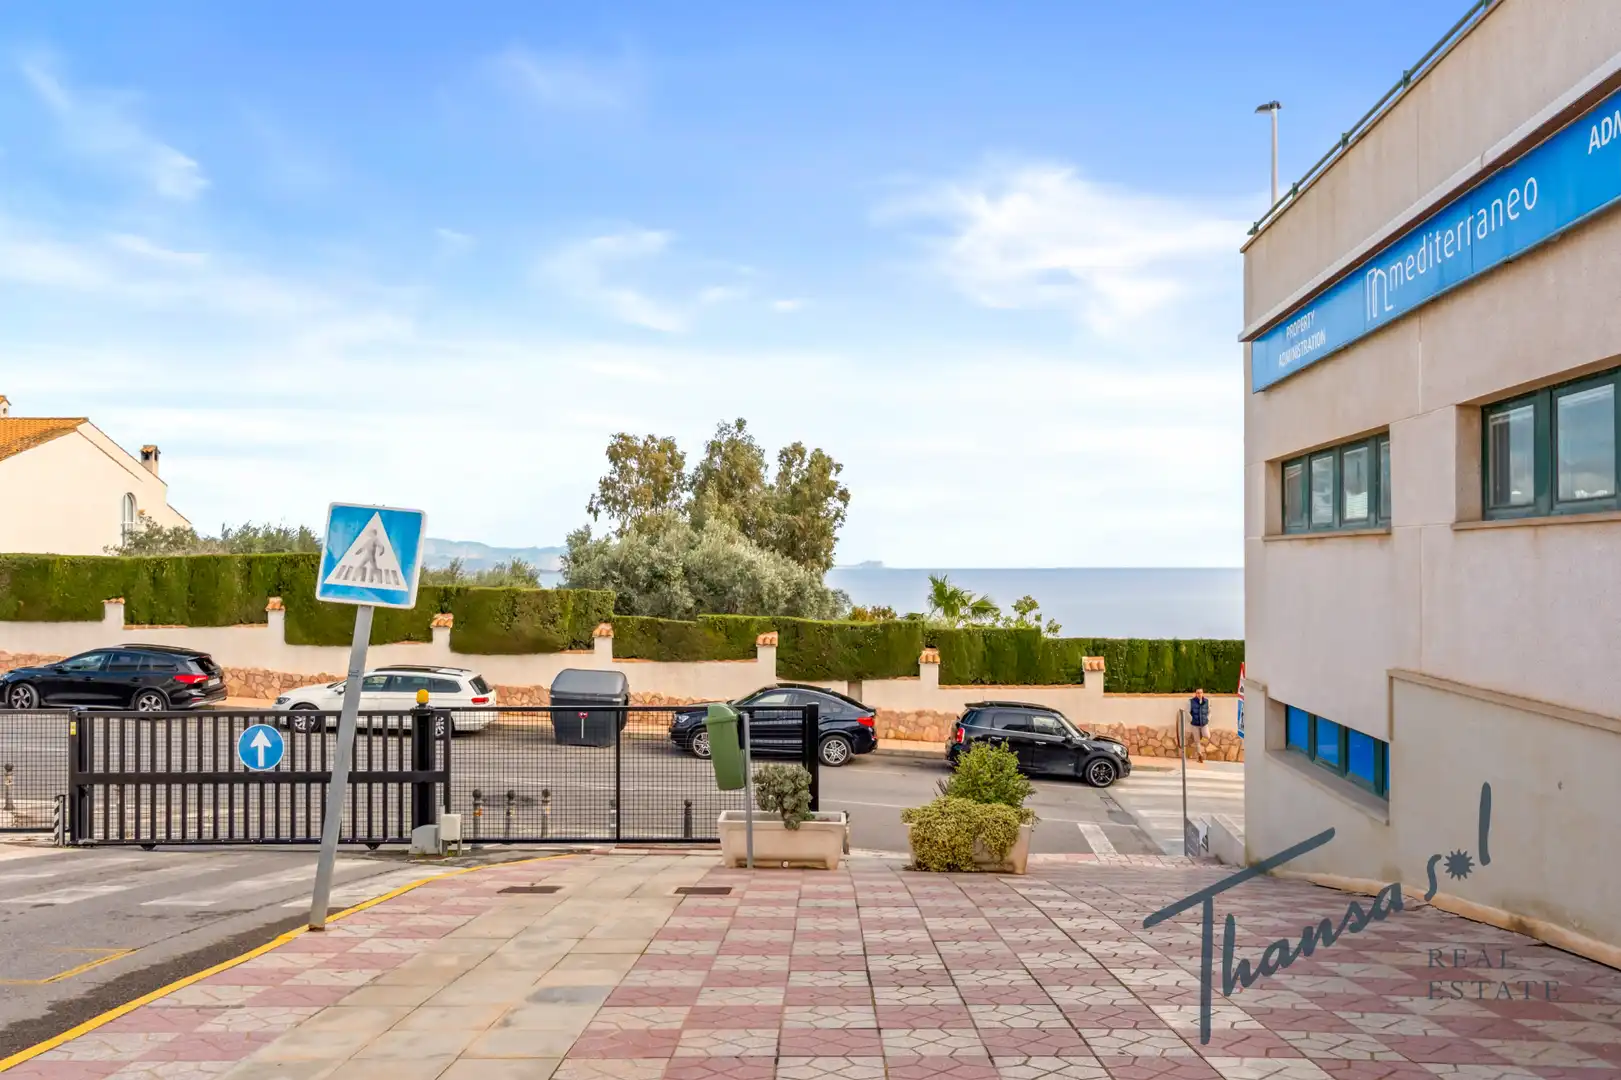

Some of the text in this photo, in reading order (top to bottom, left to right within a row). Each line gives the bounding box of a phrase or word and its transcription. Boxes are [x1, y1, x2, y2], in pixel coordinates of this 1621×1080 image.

[1389, 176, 1538, 292] mediterraneo
[1286, 309, 1315, 340] PROPERTY
[1278, 327, 1326, 368] ADMINISTRATION
